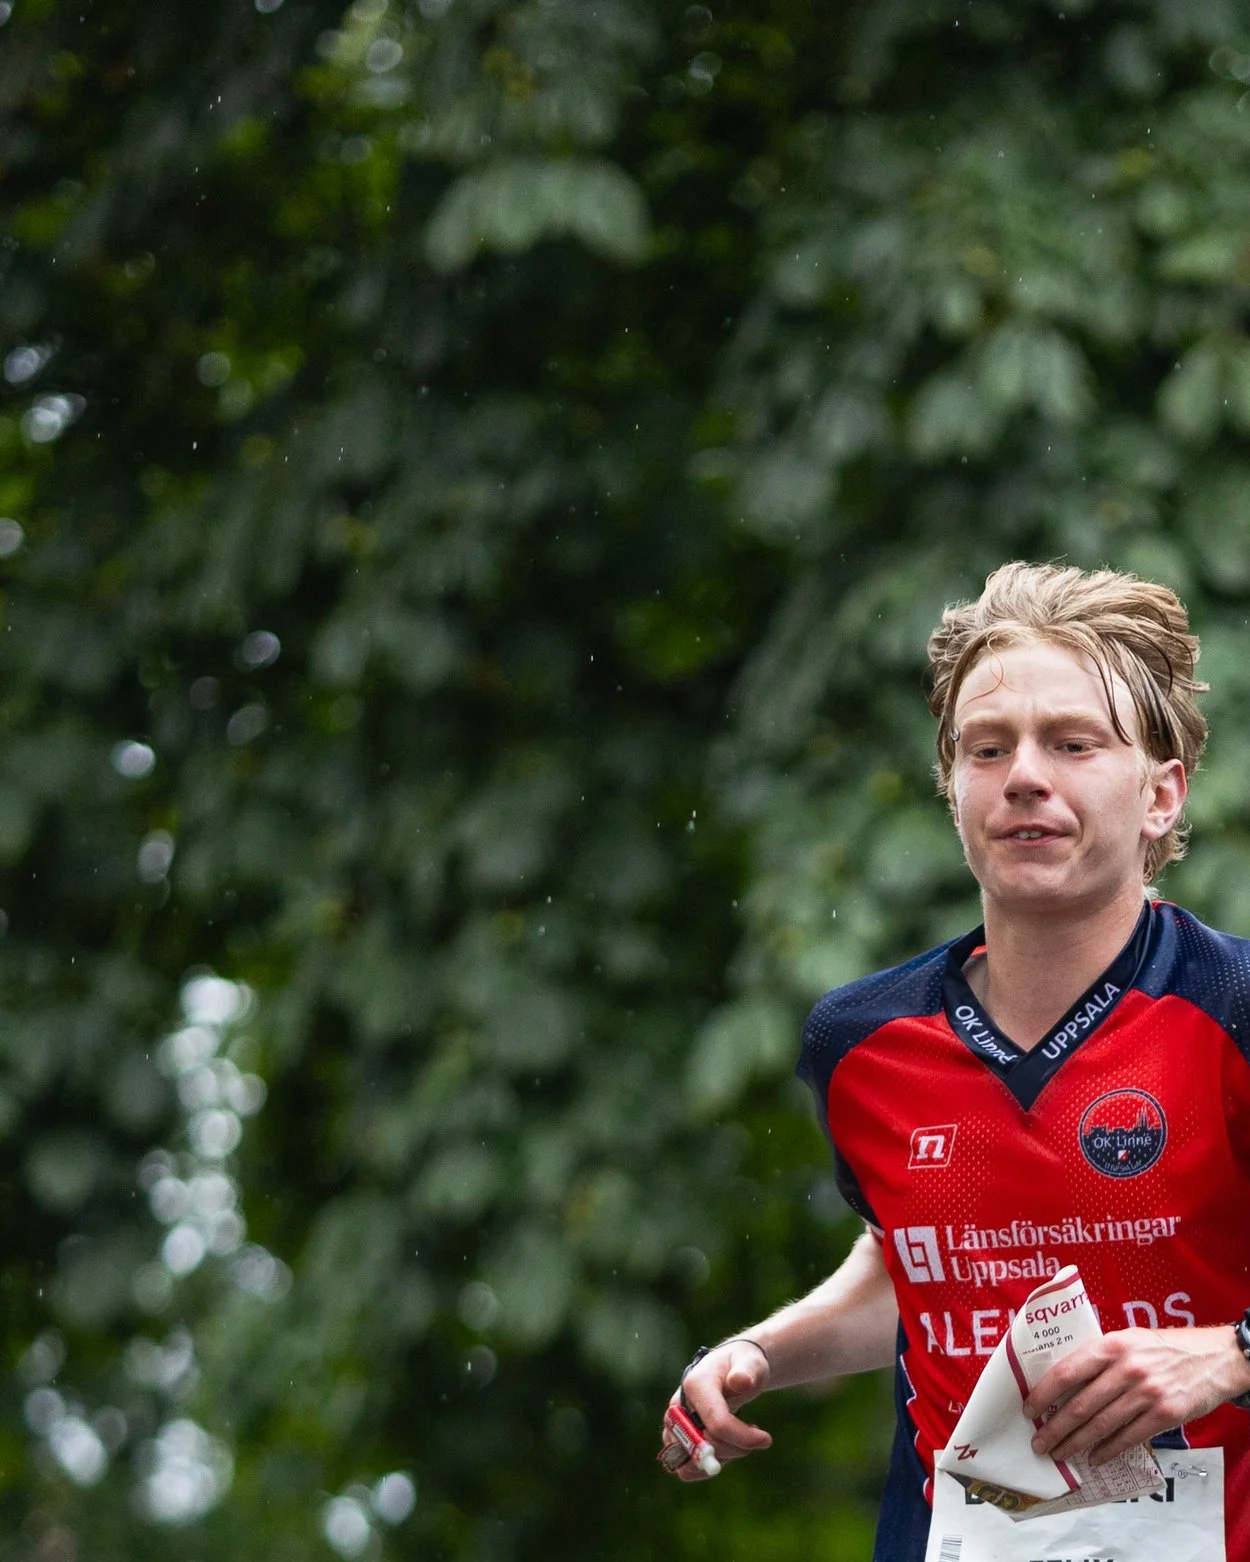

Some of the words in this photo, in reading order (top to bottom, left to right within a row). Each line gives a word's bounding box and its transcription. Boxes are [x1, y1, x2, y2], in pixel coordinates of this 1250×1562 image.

[955, 1005, 982, 1031] OK
[1041, 982, 1120, 1060] UPPSALA
[1093, 1137, 1112, 1148] OK
[946, 1216, 1182, 1250] Länsförsäkringar
[951, 1251, 1060, 1288] Uppsala
[1041, 1326, 1060, 1337] 000
[1056, 1337, 1063, 1346] 2
[1064, 1334, 1074, 1342] m
